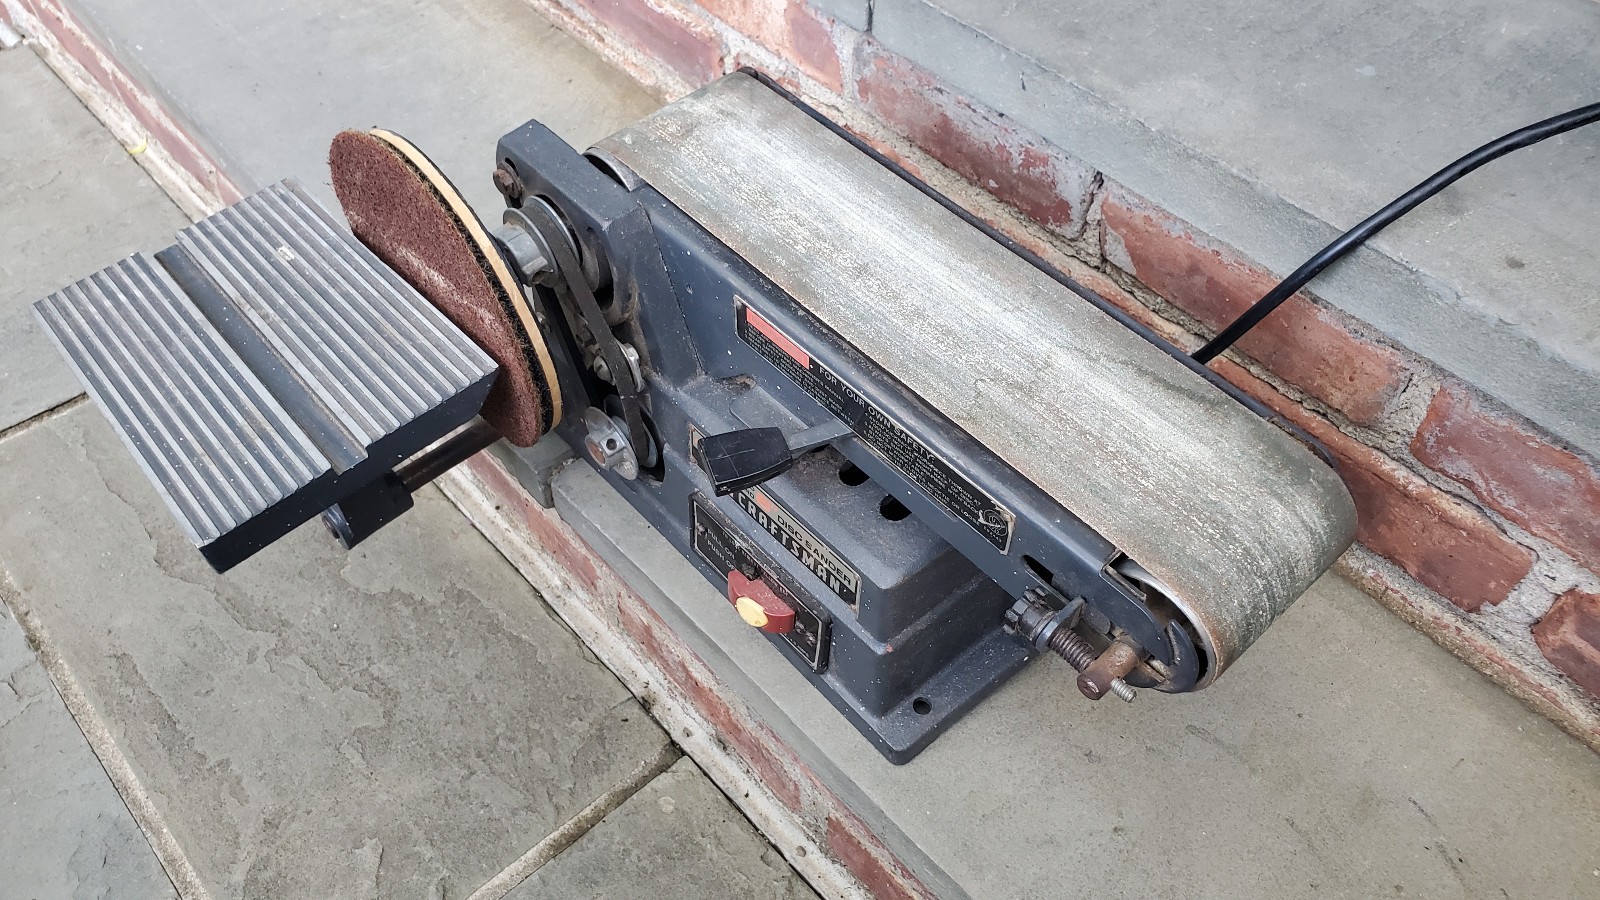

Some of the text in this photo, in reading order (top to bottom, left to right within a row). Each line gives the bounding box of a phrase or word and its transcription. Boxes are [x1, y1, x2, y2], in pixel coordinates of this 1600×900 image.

[819, 365, 935, 464] FOR YOUR OWN SAFETY:
[707, 527, 734, 560] PULL ON
[707, 539, 735, 572] PUSH OF
[735, 491, 840, 594] CRAFTSMAN
[776, 514, 851, 586] DISC SANDER
